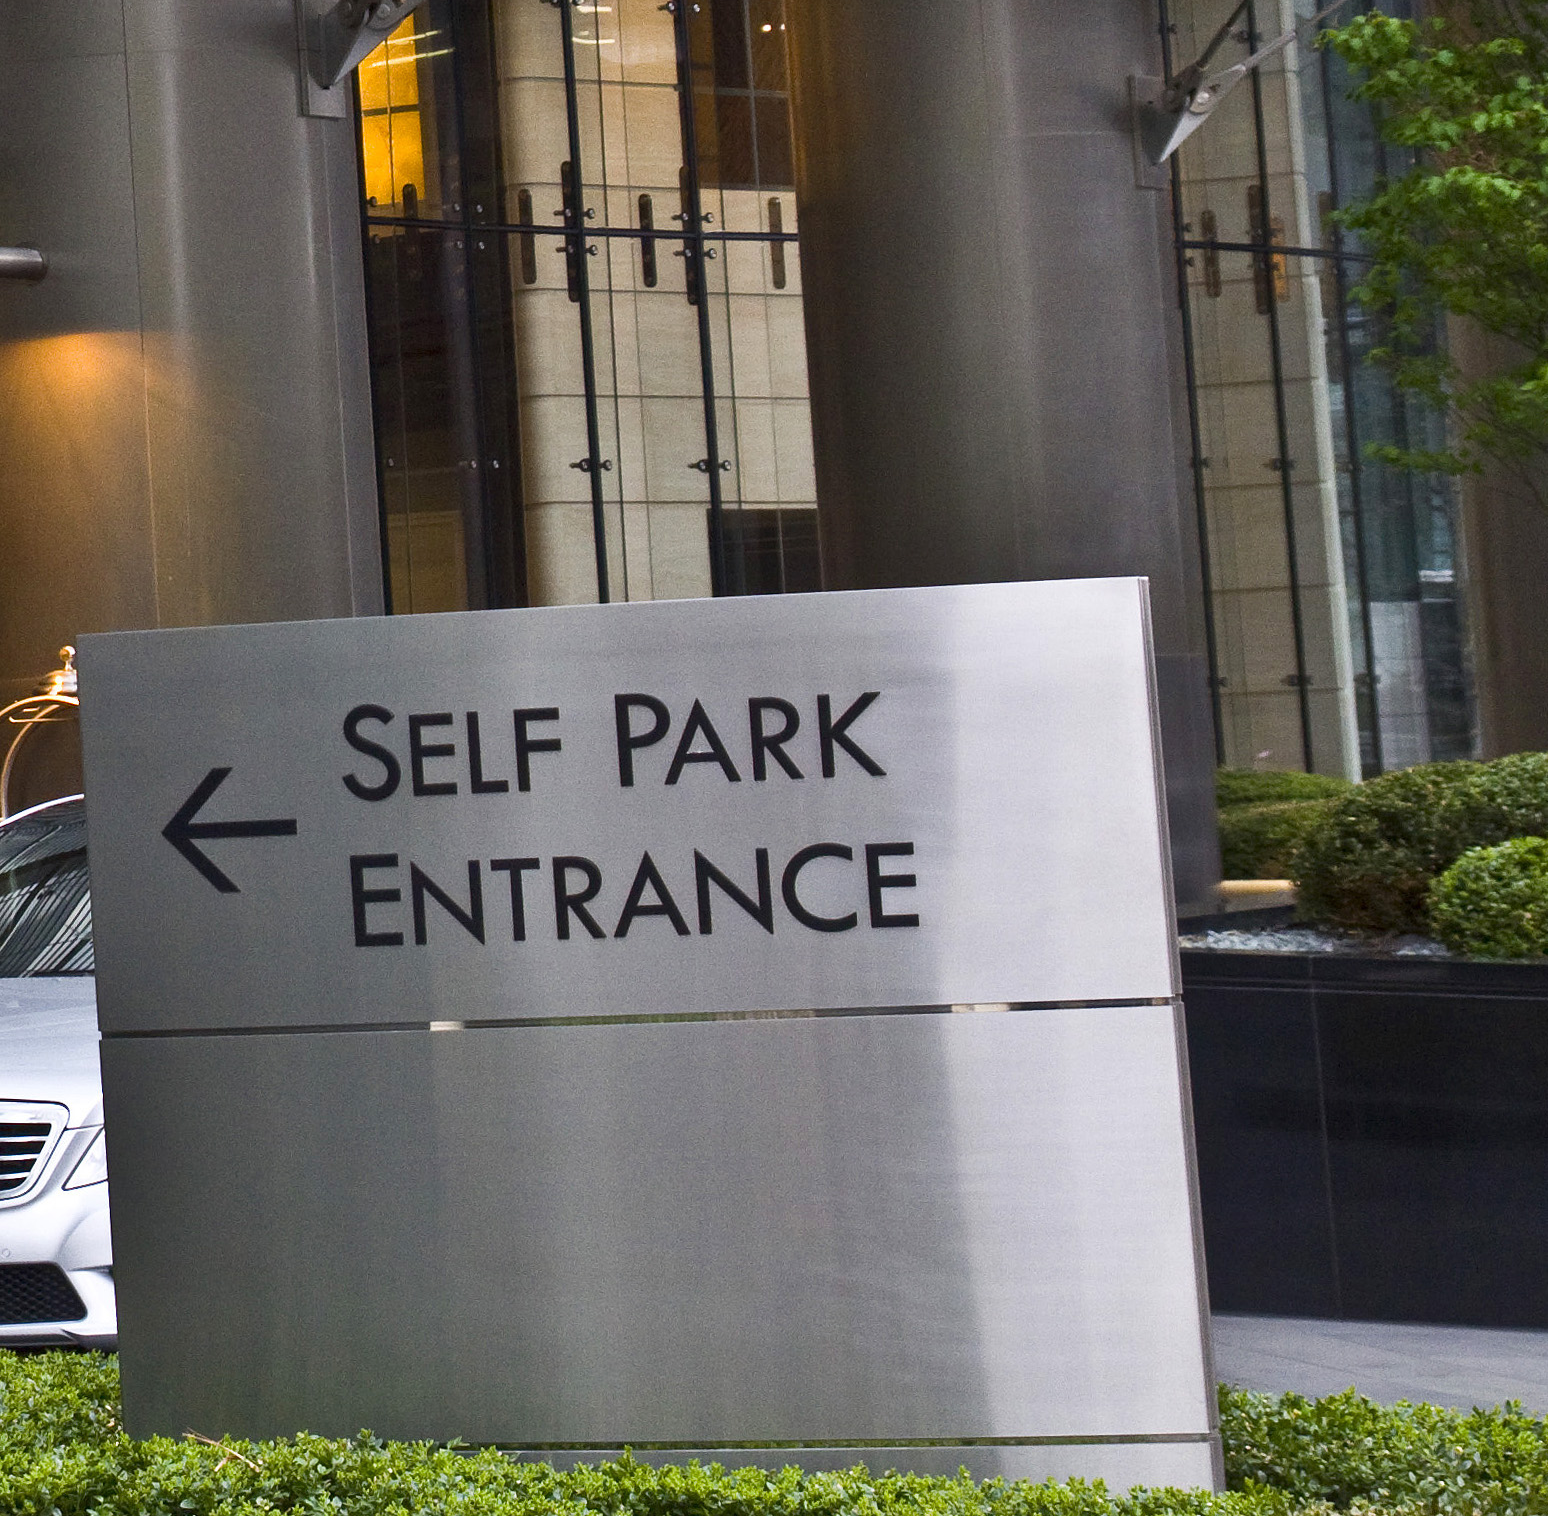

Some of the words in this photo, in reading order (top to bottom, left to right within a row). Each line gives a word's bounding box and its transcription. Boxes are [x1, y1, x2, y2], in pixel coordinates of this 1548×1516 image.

[341, 703, 562, 801] SELF
[614, 690, 887, 788] PARK
[348, 841, 921, 948] ENTRANCE
